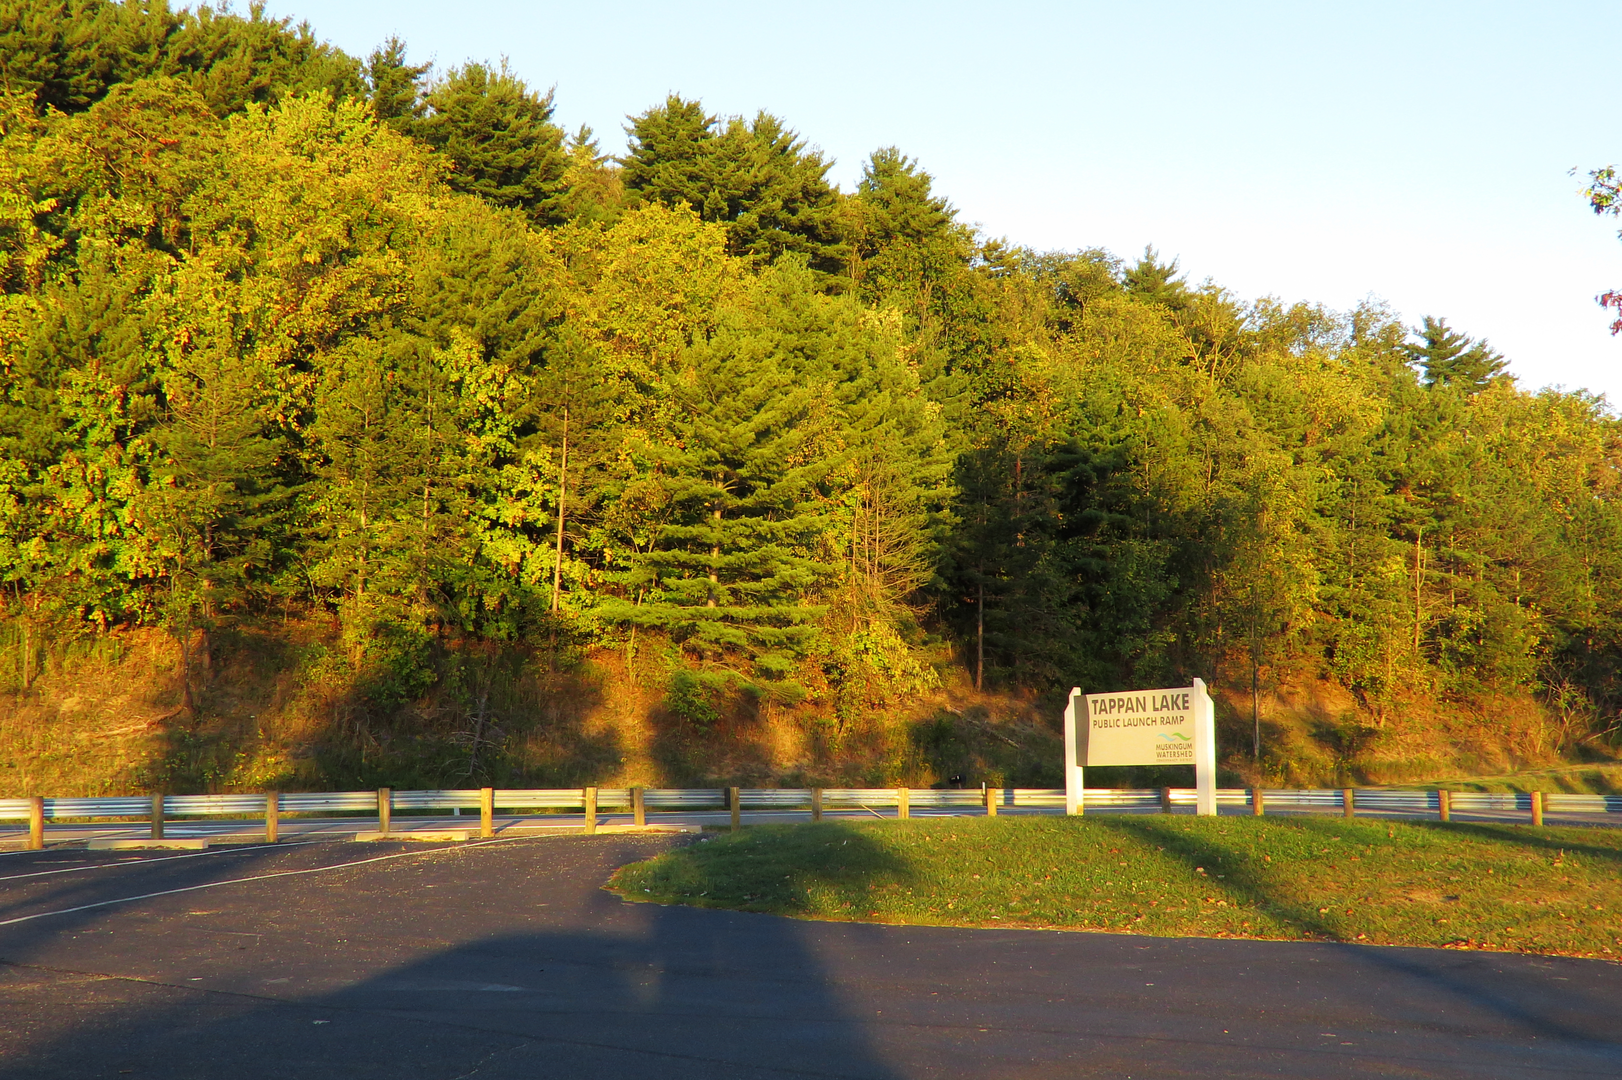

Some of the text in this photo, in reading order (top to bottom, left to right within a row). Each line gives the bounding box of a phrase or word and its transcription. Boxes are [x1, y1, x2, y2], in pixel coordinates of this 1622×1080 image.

[1091, 693, 1190, 715] TAPPAN LAKE
[1093, 715, 1185, 729] PUBLIC LAUNCH RAMP
[1155, 743, 1193, 751] MUSKINGUM
[1155, 750, 1193, 758] WATERSHED
